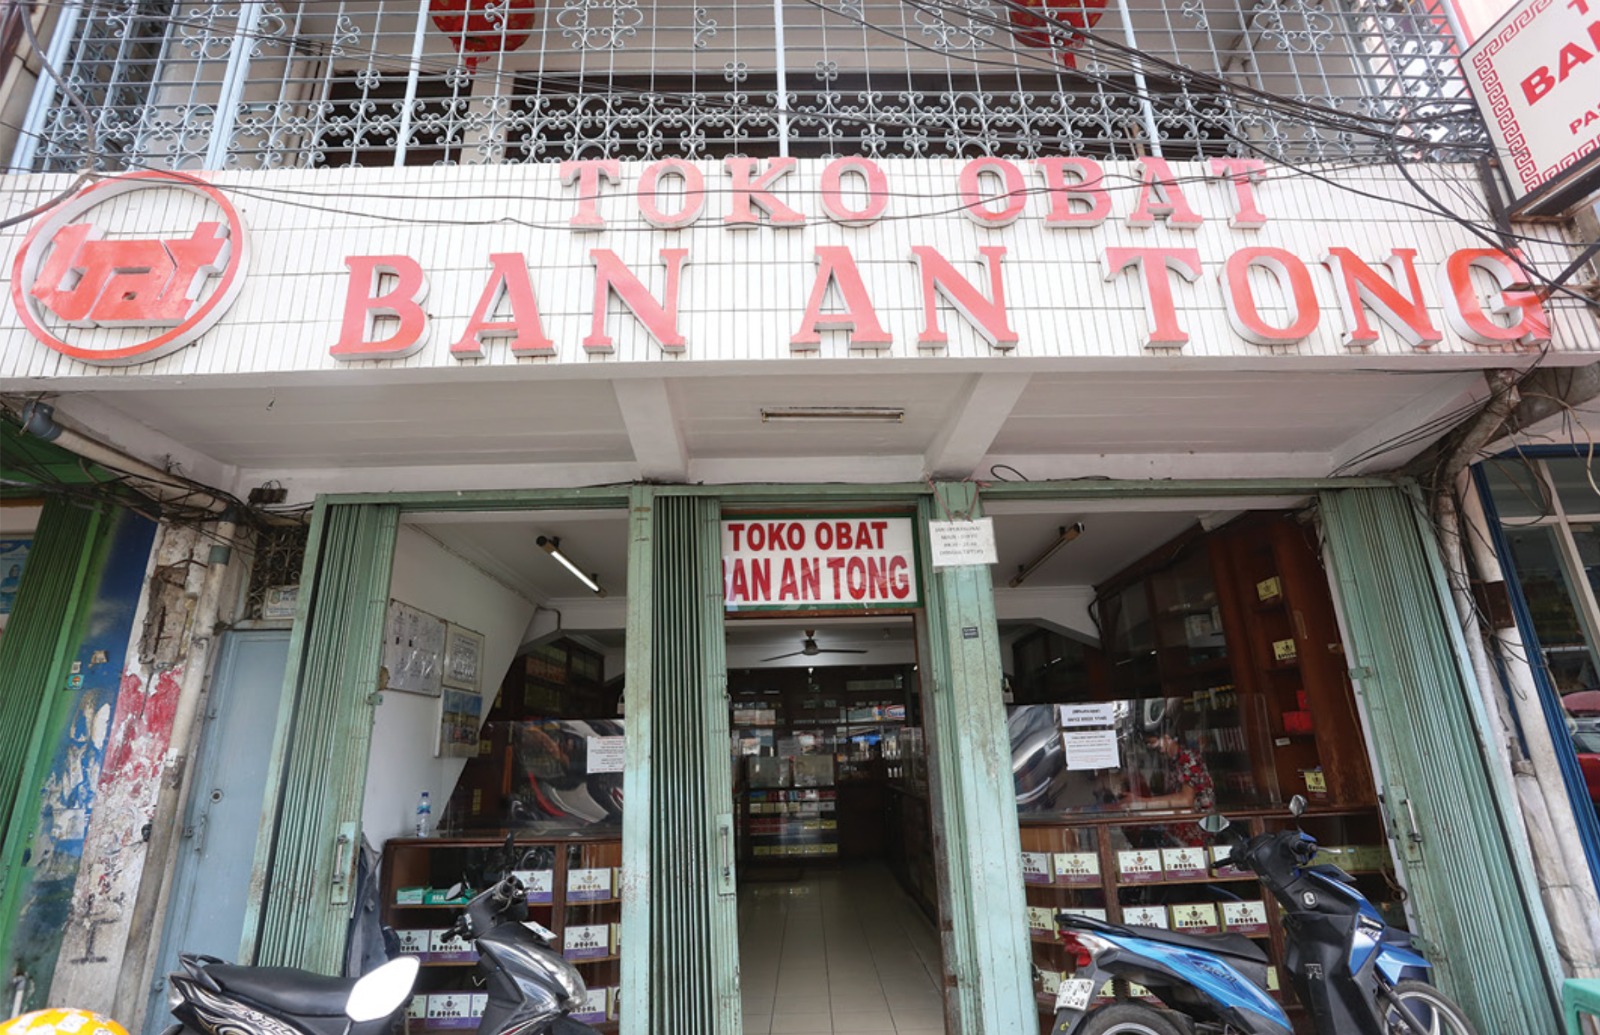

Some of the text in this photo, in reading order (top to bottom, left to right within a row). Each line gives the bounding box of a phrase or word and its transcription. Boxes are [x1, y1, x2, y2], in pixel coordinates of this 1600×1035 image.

[1569, 102, 1600, 135] PA
[560, 156, 1268, 230] TOKO OBAT
[330, 246, 1554, 361] BAN AN TONG
[728, 521, 888, 551] TOKO OBAT
[722, 555, 910, 601] AN AN TONG
